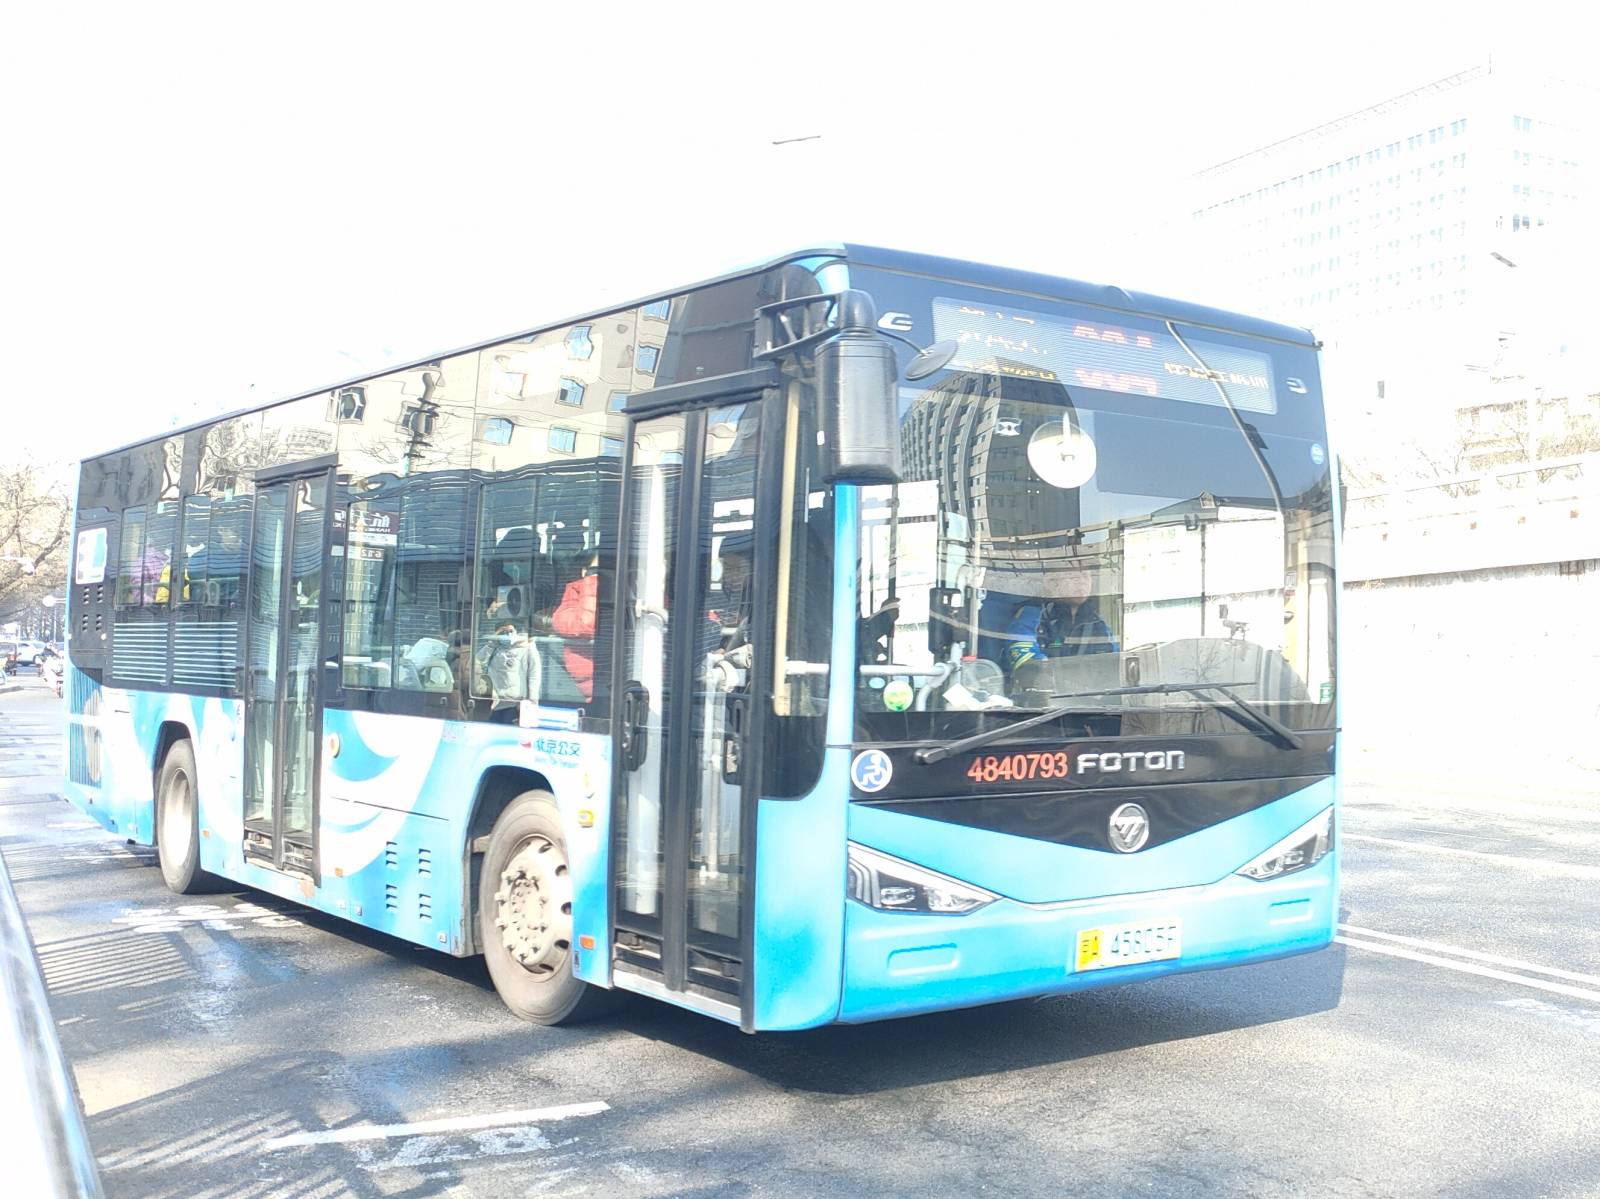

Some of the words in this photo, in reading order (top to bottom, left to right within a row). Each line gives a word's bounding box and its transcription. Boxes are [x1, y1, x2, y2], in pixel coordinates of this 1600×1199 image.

[533, 736, 581, 756] 北京公交
[967, 752, 1069, 782] 4840793
[1076, 750, 1186, 775] FOTON
